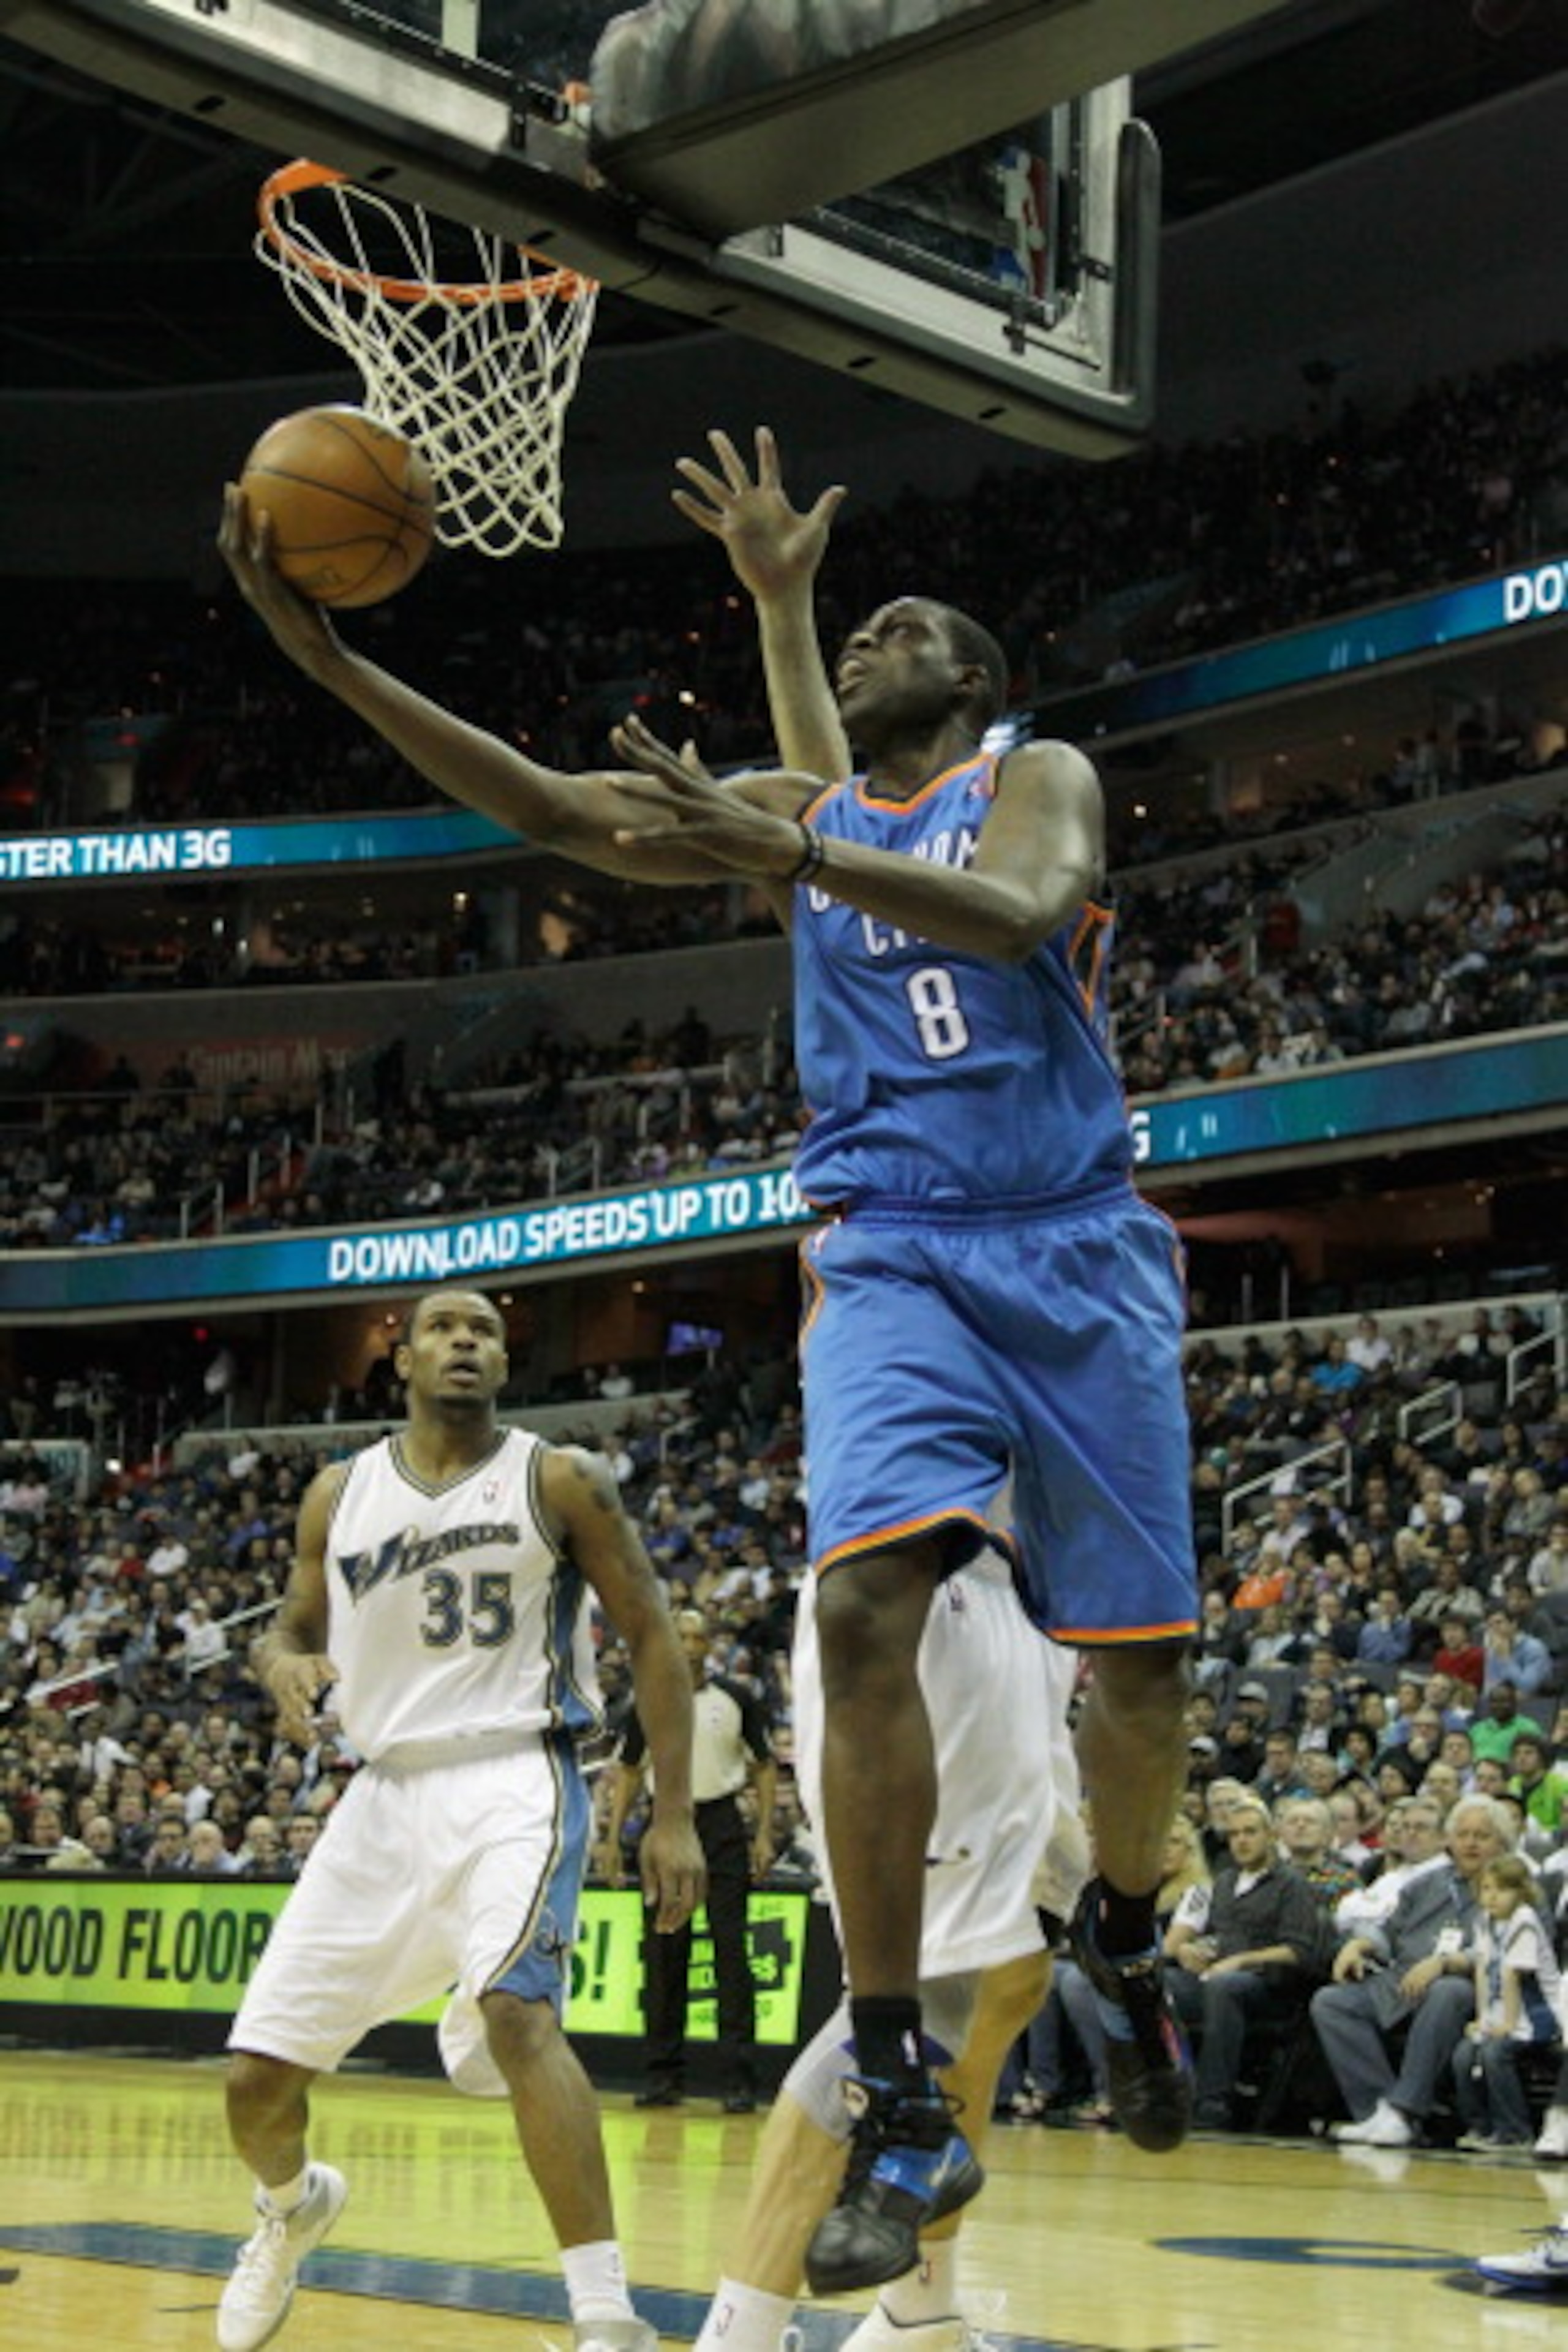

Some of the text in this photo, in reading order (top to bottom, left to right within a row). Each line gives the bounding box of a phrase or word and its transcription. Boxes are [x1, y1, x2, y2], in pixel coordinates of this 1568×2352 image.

[1503, 560, 1568, 622] DO
[78, 833, 176, 873] THAN
[181, 829, 232, 869] 3G
[907, 968, 969, 1059] 8
[330, 1171, 810, 1280] DOWNLOAD SPEEDS UP TO 10
[420, 1569, 515, 1648] 35
